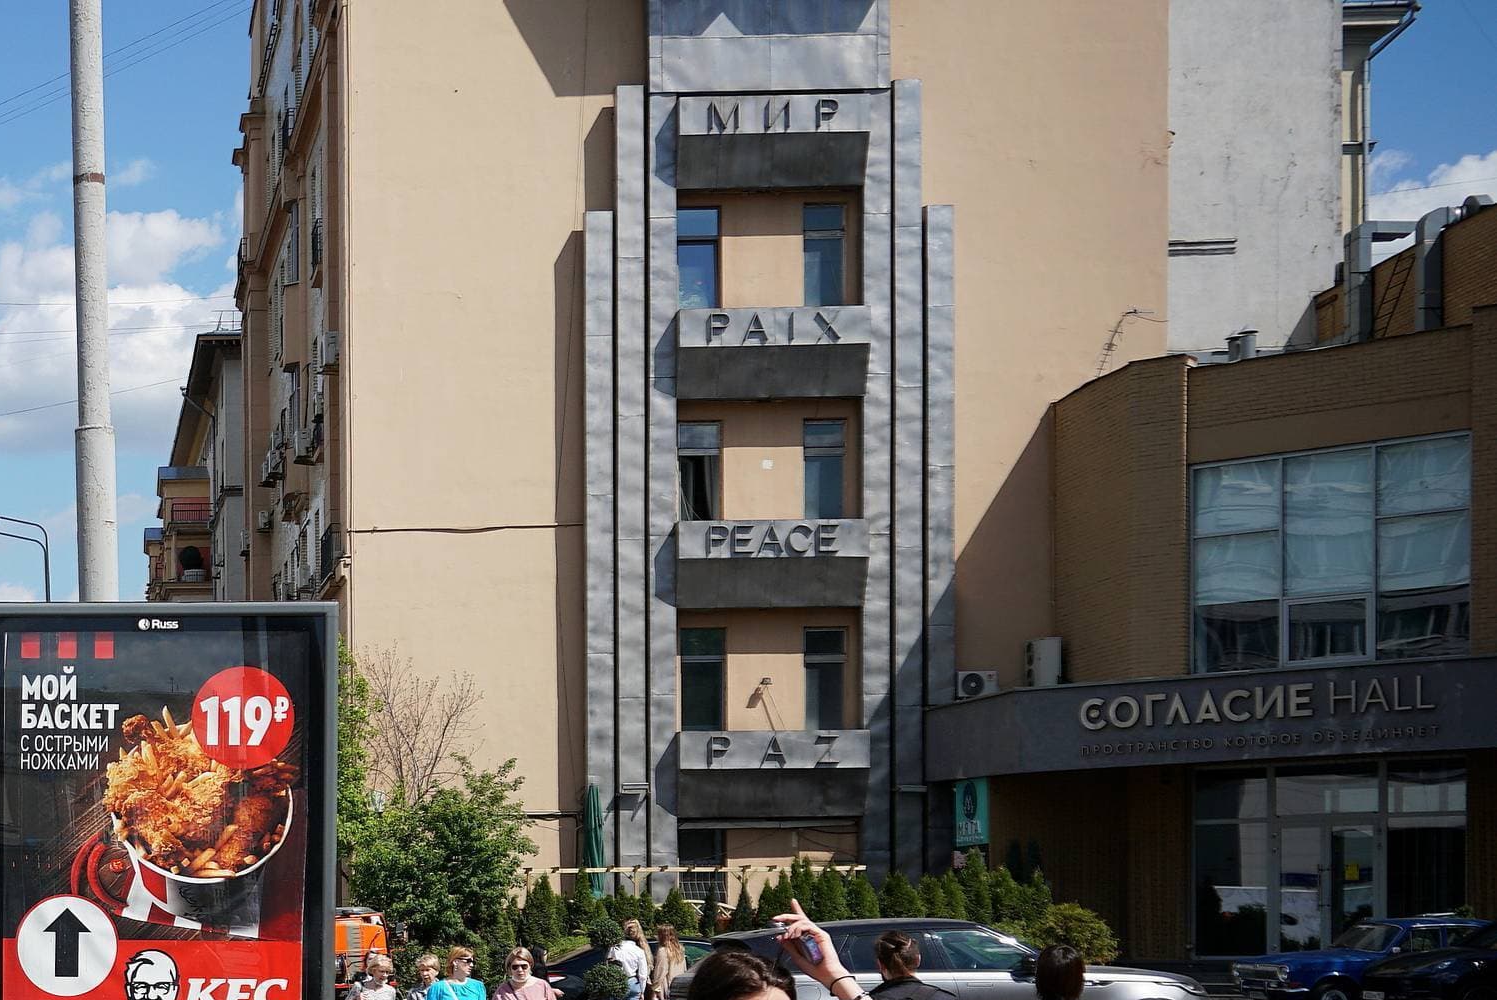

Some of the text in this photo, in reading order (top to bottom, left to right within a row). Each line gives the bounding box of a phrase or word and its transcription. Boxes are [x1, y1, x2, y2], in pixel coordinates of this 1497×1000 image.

[707, 98, 839, 134] МИР
[706, 310, 841, 345] PAIX
[705, 523, 840, 558] PEACE
[151, 618, 179, 629] Russ
[21, 665, 77, 701] МОЙ
[21, 703, 119, 730] БАСКЕТ
[1080, 675, 1436, 730] СОГЛАСИЕ HALL
[20, 734, 109, 753] С ОСТРЫМИ
[706, 734, 840, 769] PAZ
[1080, 725, 1440, 757] ПРОСТРАНСТВО КОТОРОЕ ОБЪЕДИНЯЕТ
[20, 753, 99, 771] НОЖКАМИ
